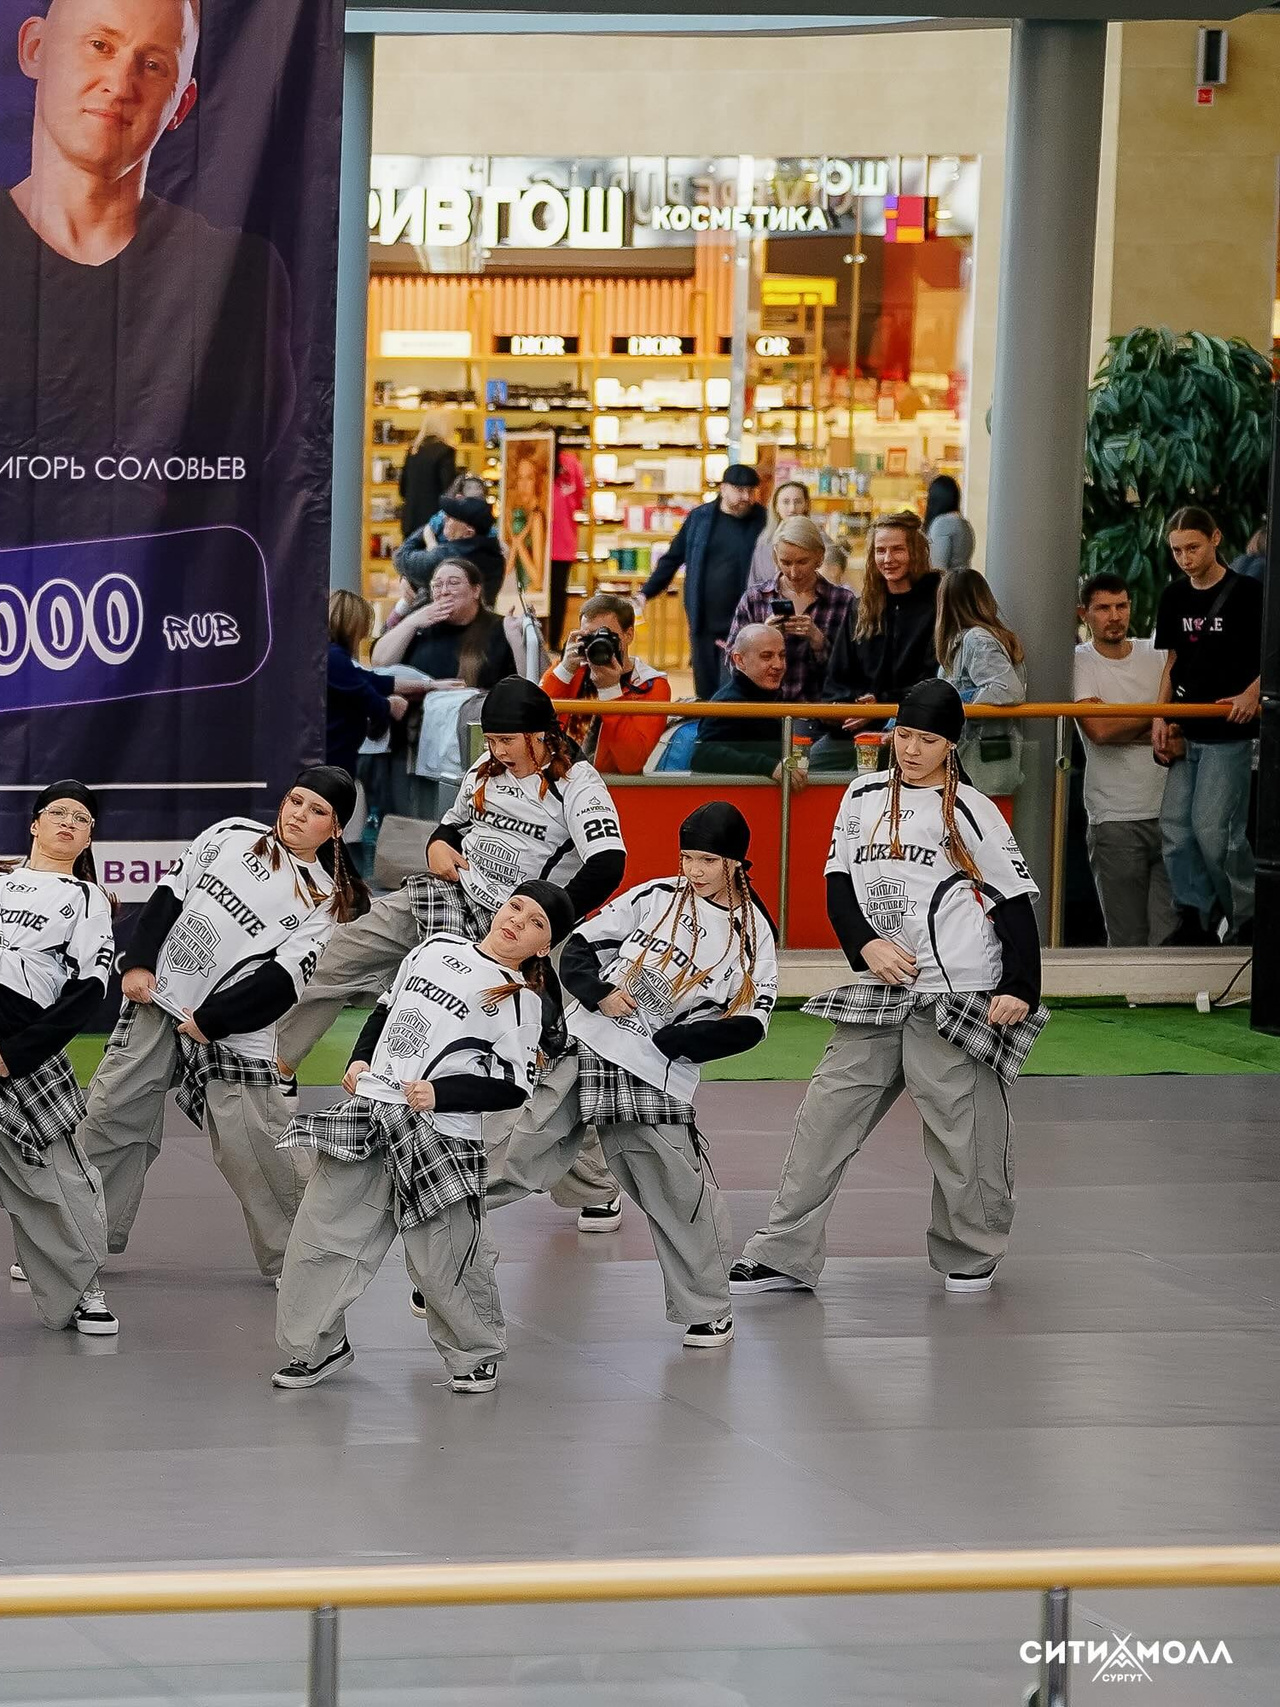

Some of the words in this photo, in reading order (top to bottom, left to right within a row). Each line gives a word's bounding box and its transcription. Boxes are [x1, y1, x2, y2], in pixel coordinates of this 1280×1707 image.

[480, 184, 623, 248] ГОШ
[651, 205, 828, 232] КОСМЕТИКА
[511, 335, 565, 357] DIOR
[628, 335, 683, 357] DIOR
[754, 335, 790, 357] OR
[95, 456, 247, 481] СОЛОВЬЕВ
[162, 612, 240, 651] RUB
[583, 818, 621, 843] 22
[853, 841, 938, 868] DUCKIVE
[404, 974, 471, 1022] UCKDIVE
